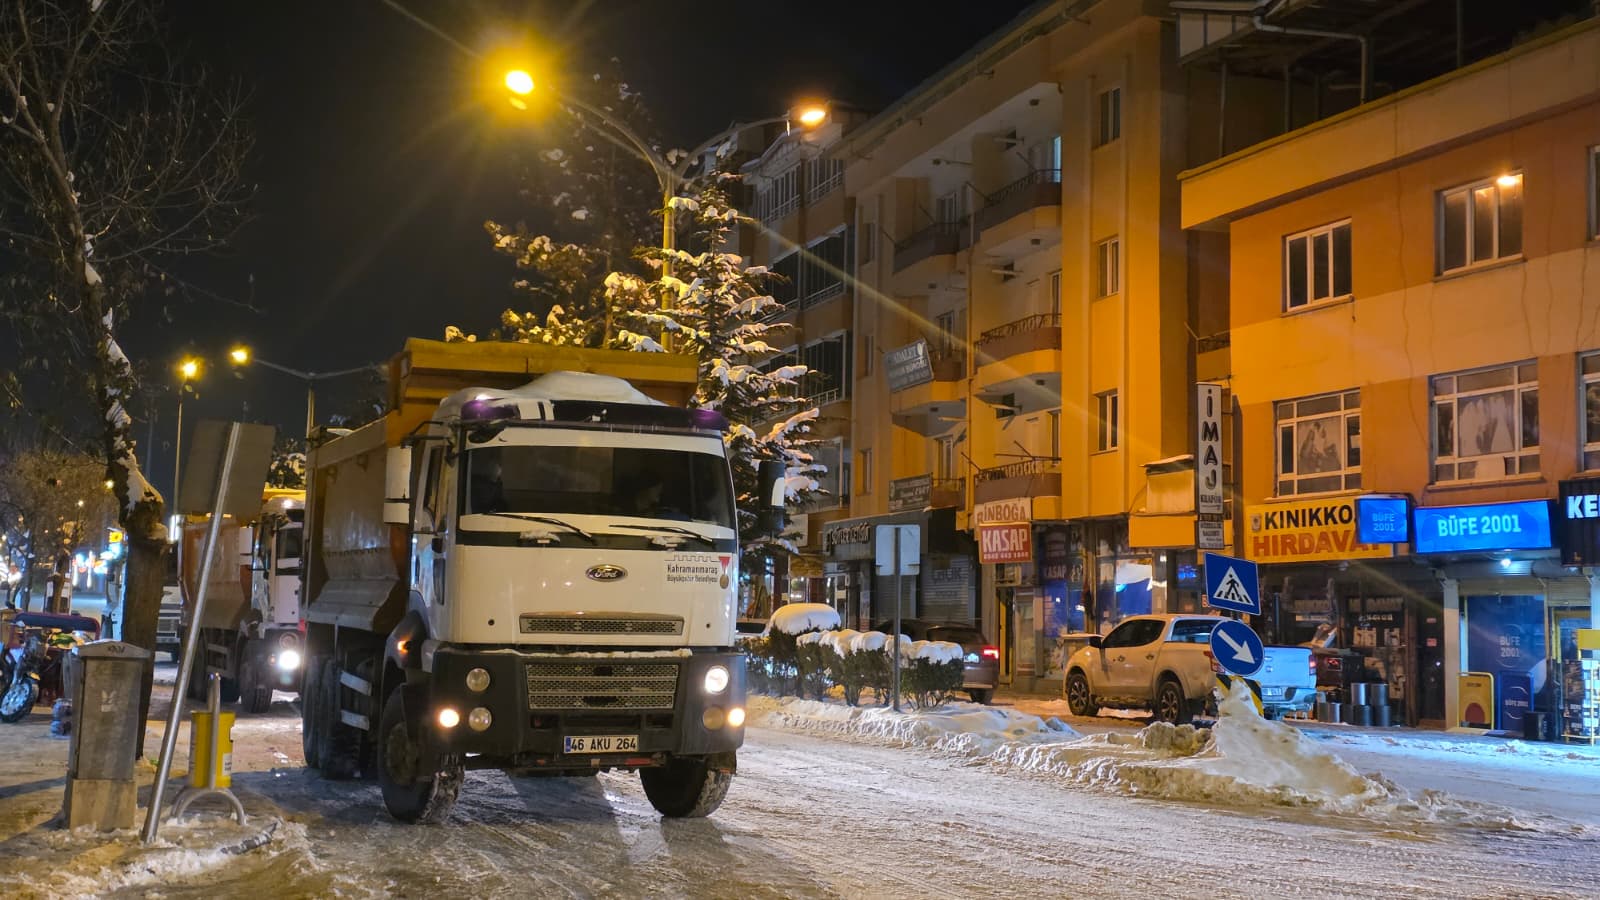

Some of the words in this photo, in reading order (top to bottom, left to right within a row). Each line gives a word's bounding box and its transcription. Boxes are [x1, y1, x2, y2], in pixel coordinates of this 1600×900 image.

[1264, 504, 1357, 531] KINIKKO
[1567, 494, 1600, 519] KE
[1373, 523, 1396, 532] 2001
[1437, 515, 1478, 537] BÜFE
[1480, 514, 1522, 534] 2001
[982, 528, 1028, 553] KASAP
[571, 739, 585, 751] 46
[590, 738, 611, 751] AKU
[616, 738, 636, 750] 264
